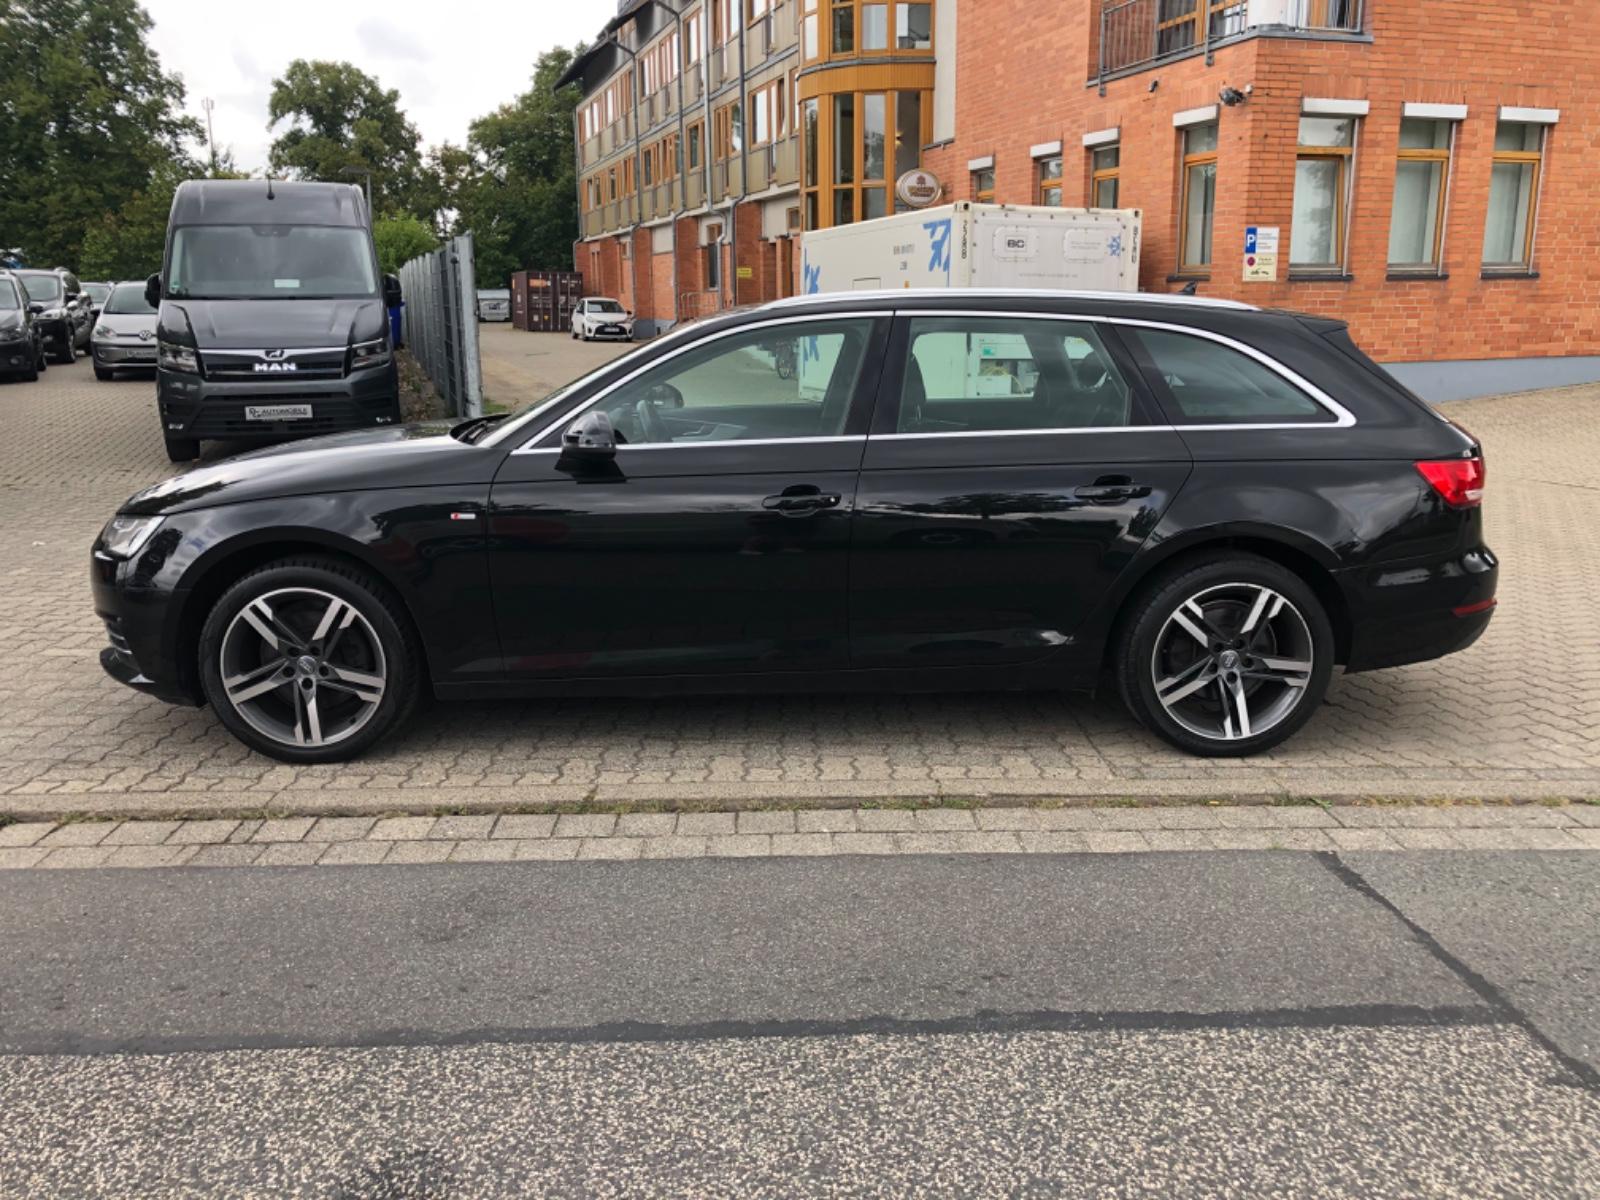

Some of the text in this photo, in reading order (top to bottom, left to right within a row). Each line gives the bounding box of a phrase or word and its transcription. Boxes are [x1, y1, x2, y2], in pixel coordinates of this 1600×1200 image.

[1007, 239, 1025, 249] BC
[1247, 234, 1256, 248] P
[254, 362, 297, 372] MAN
